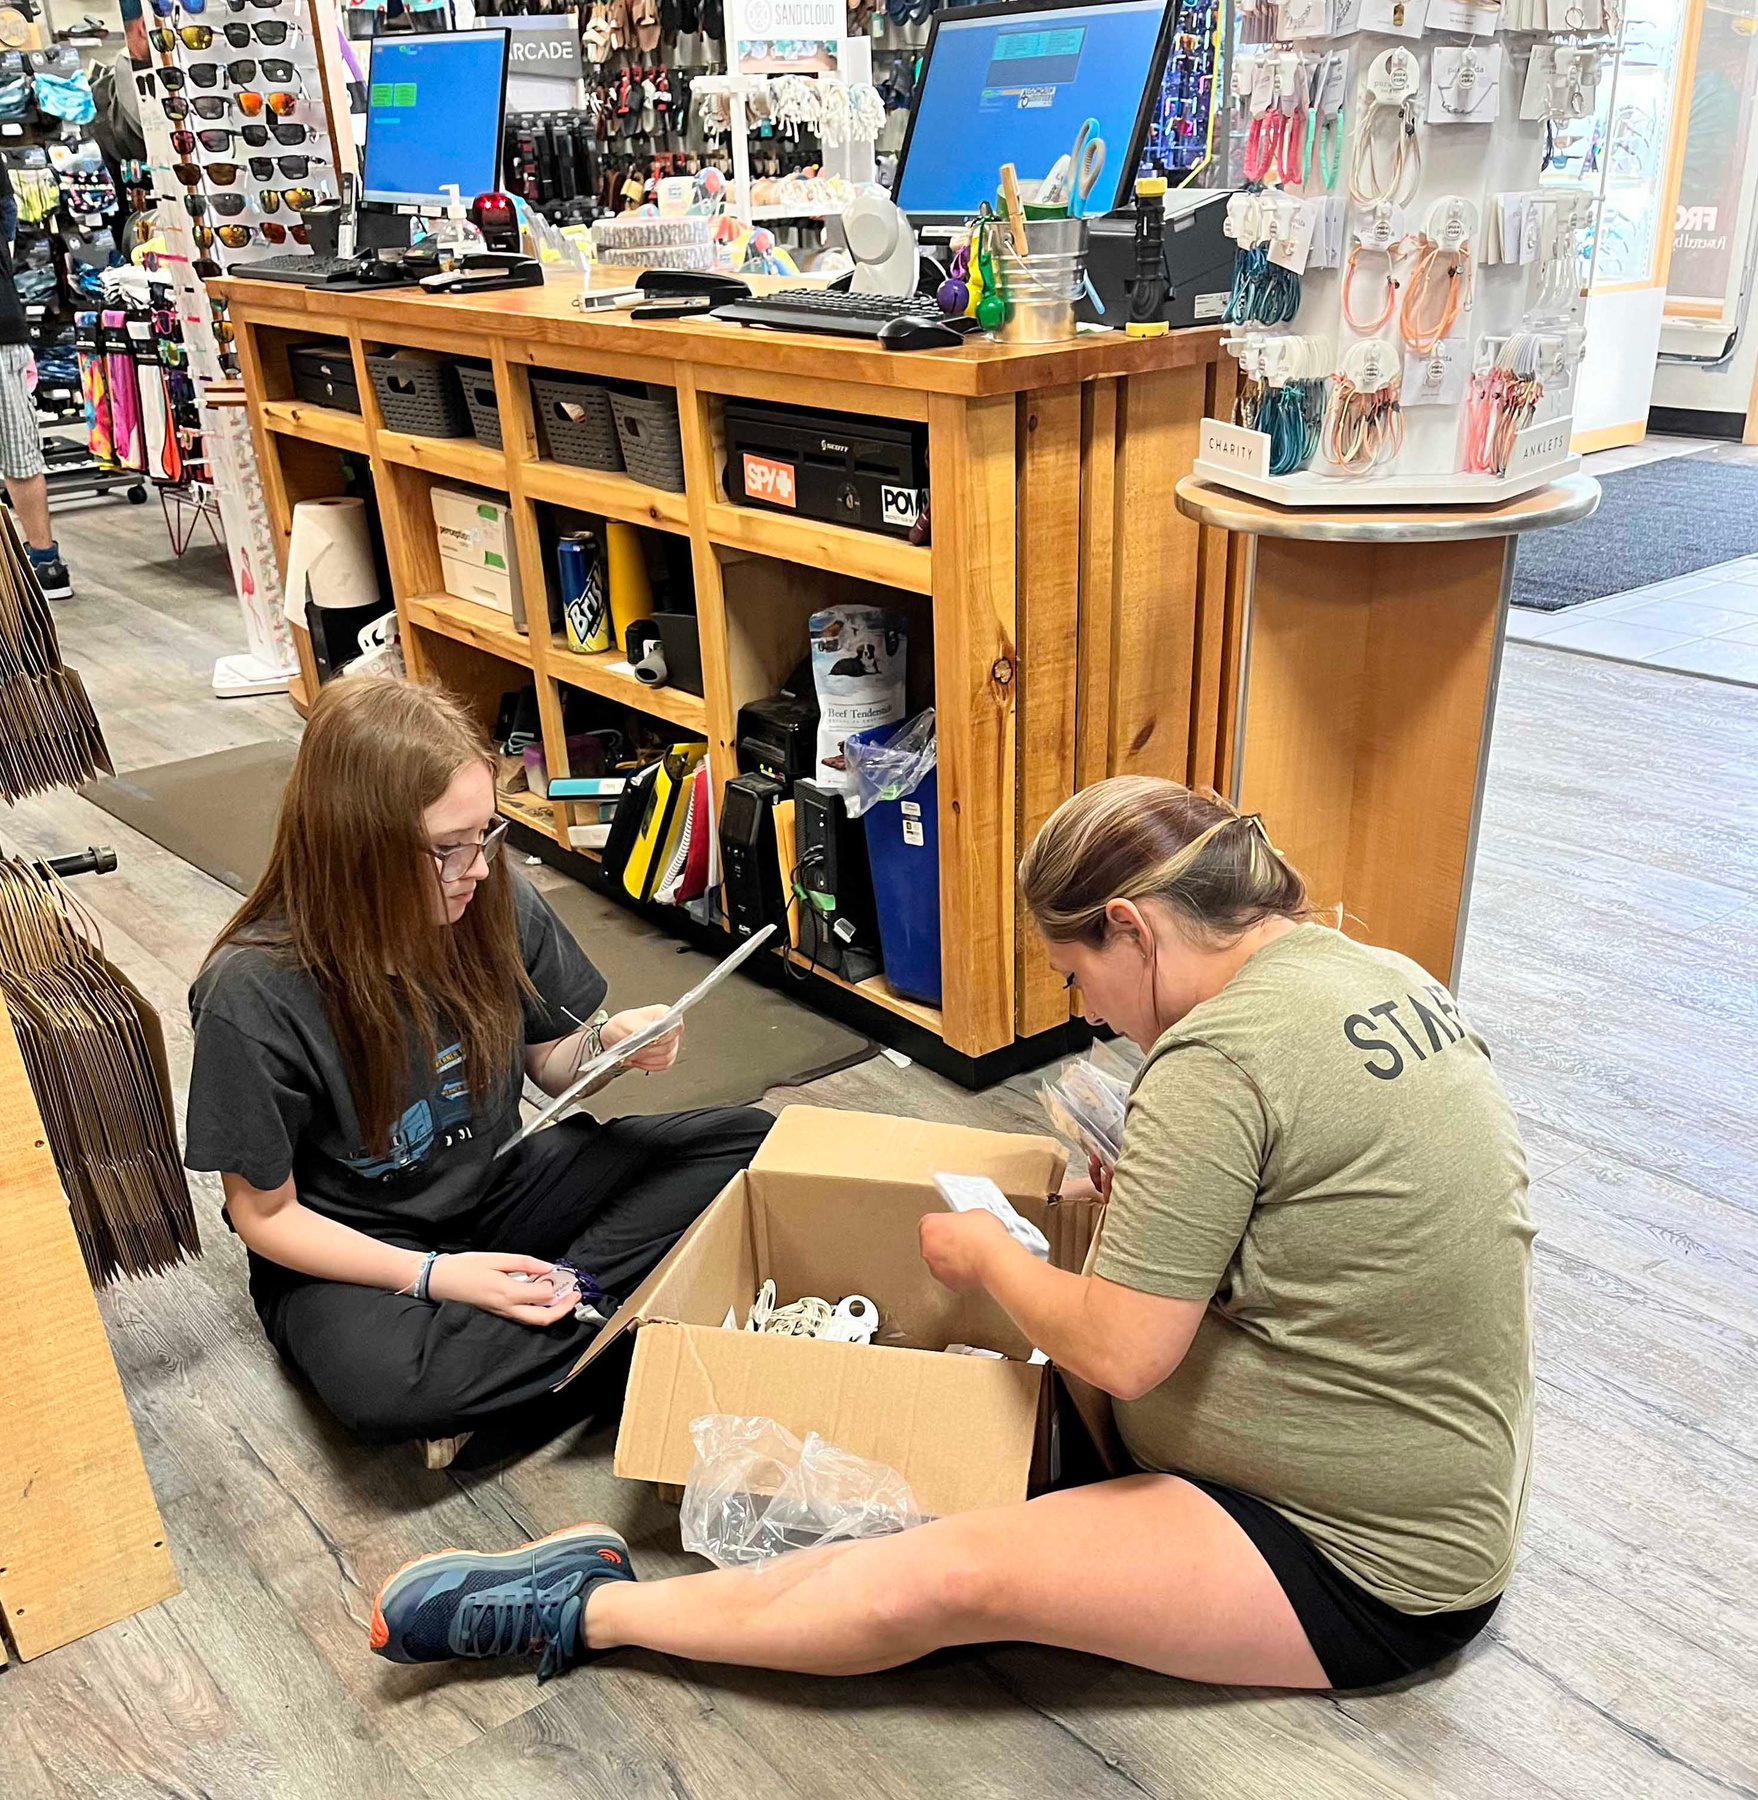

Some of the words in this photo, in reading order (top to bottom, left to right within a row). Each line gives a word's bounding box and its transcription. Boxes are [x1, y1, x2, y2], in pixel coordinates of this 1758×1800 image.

[826, 442, 849, 453] SCOTT
[1209, 437, 1253, 460] CHARITY
[1523, 435, 1563, 459] ANKLETS
[828, 708, 848, 718] Beef
